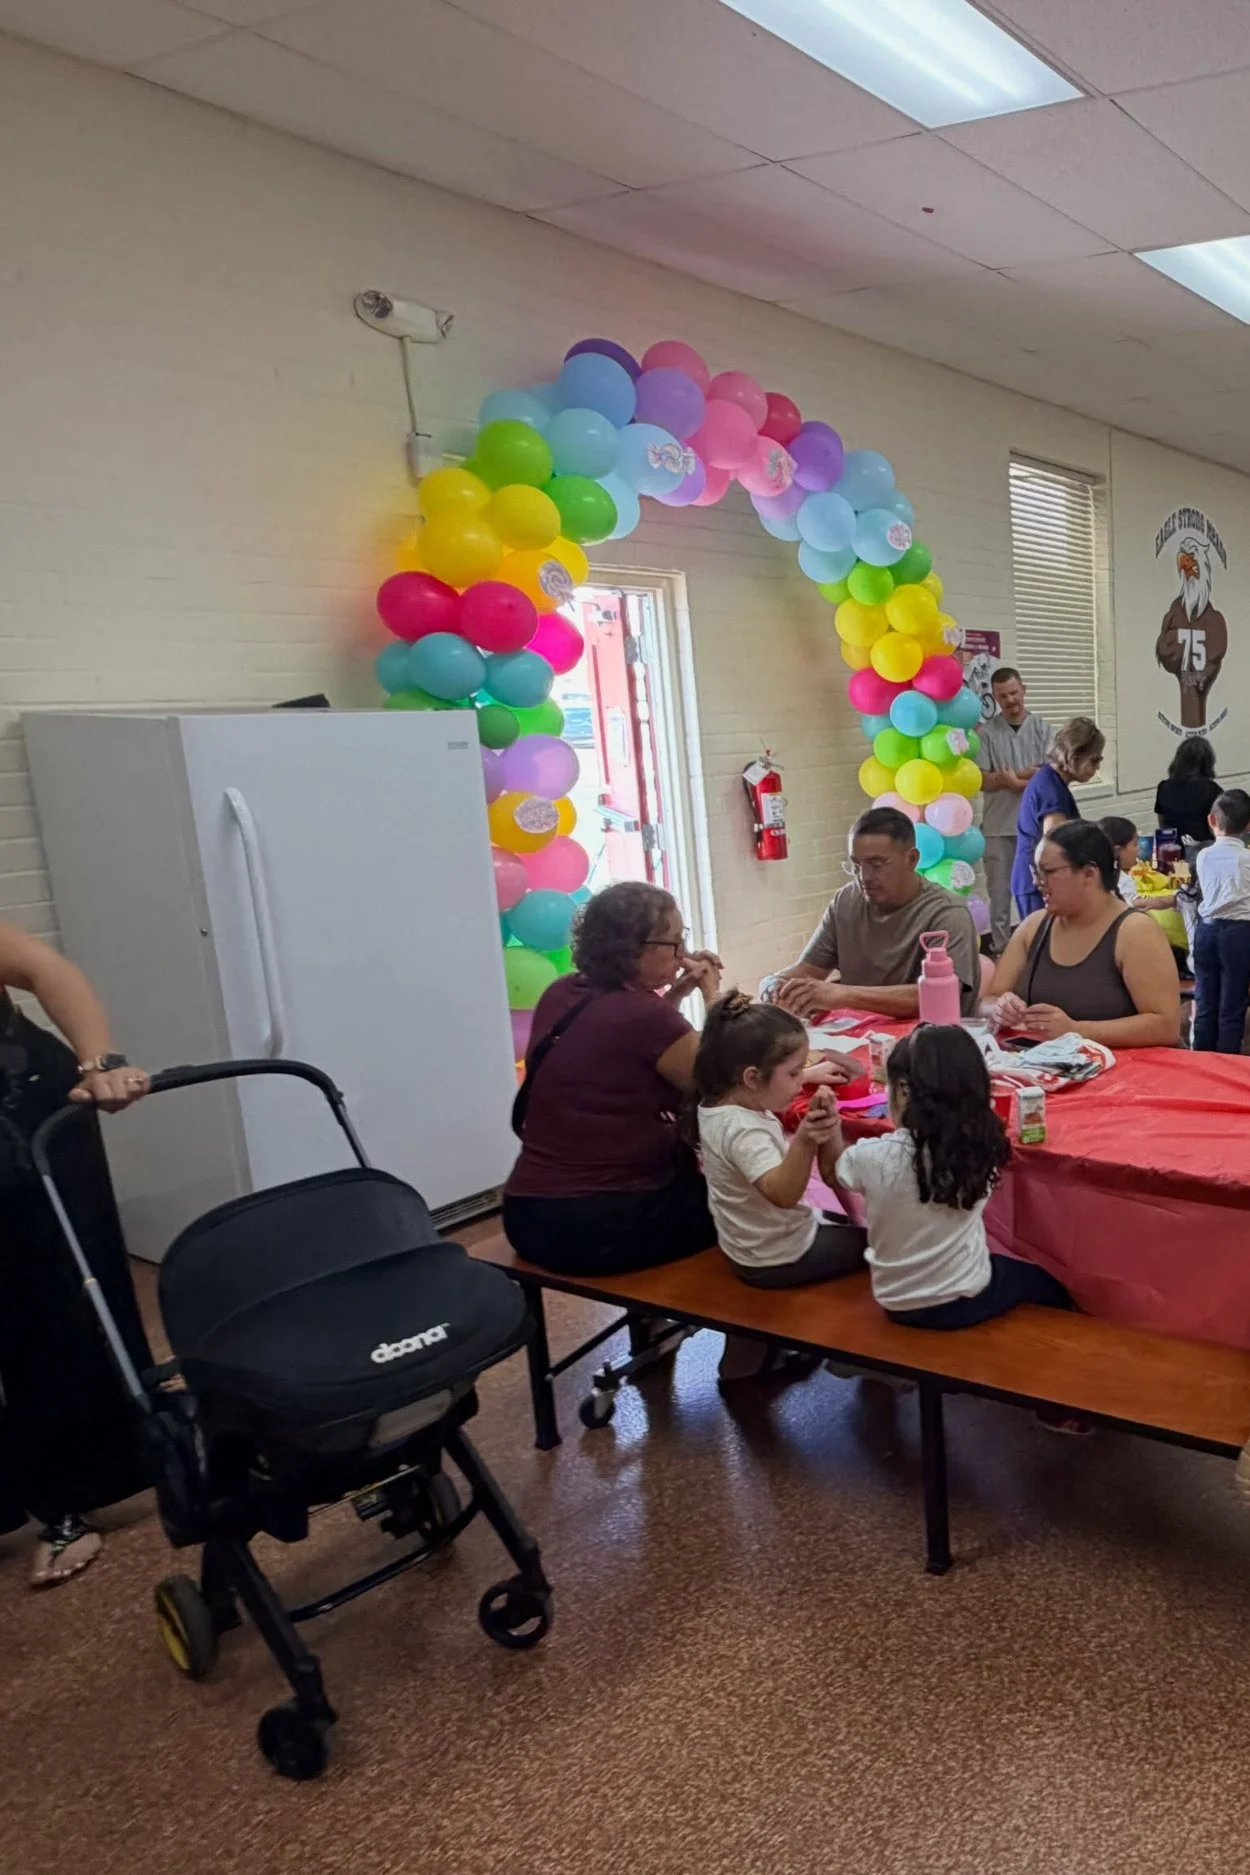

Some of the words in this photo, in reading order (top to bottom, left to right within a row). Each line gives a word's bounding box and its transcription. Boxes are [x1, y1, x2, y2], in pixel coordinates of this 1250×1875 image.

[1155, 511, 1177, 559] EAGLE
[1178, 507, 1205, 534] STRONG
[1178, 628, 1207, 672] 75
[370, 1325, 448, 1364] doona
